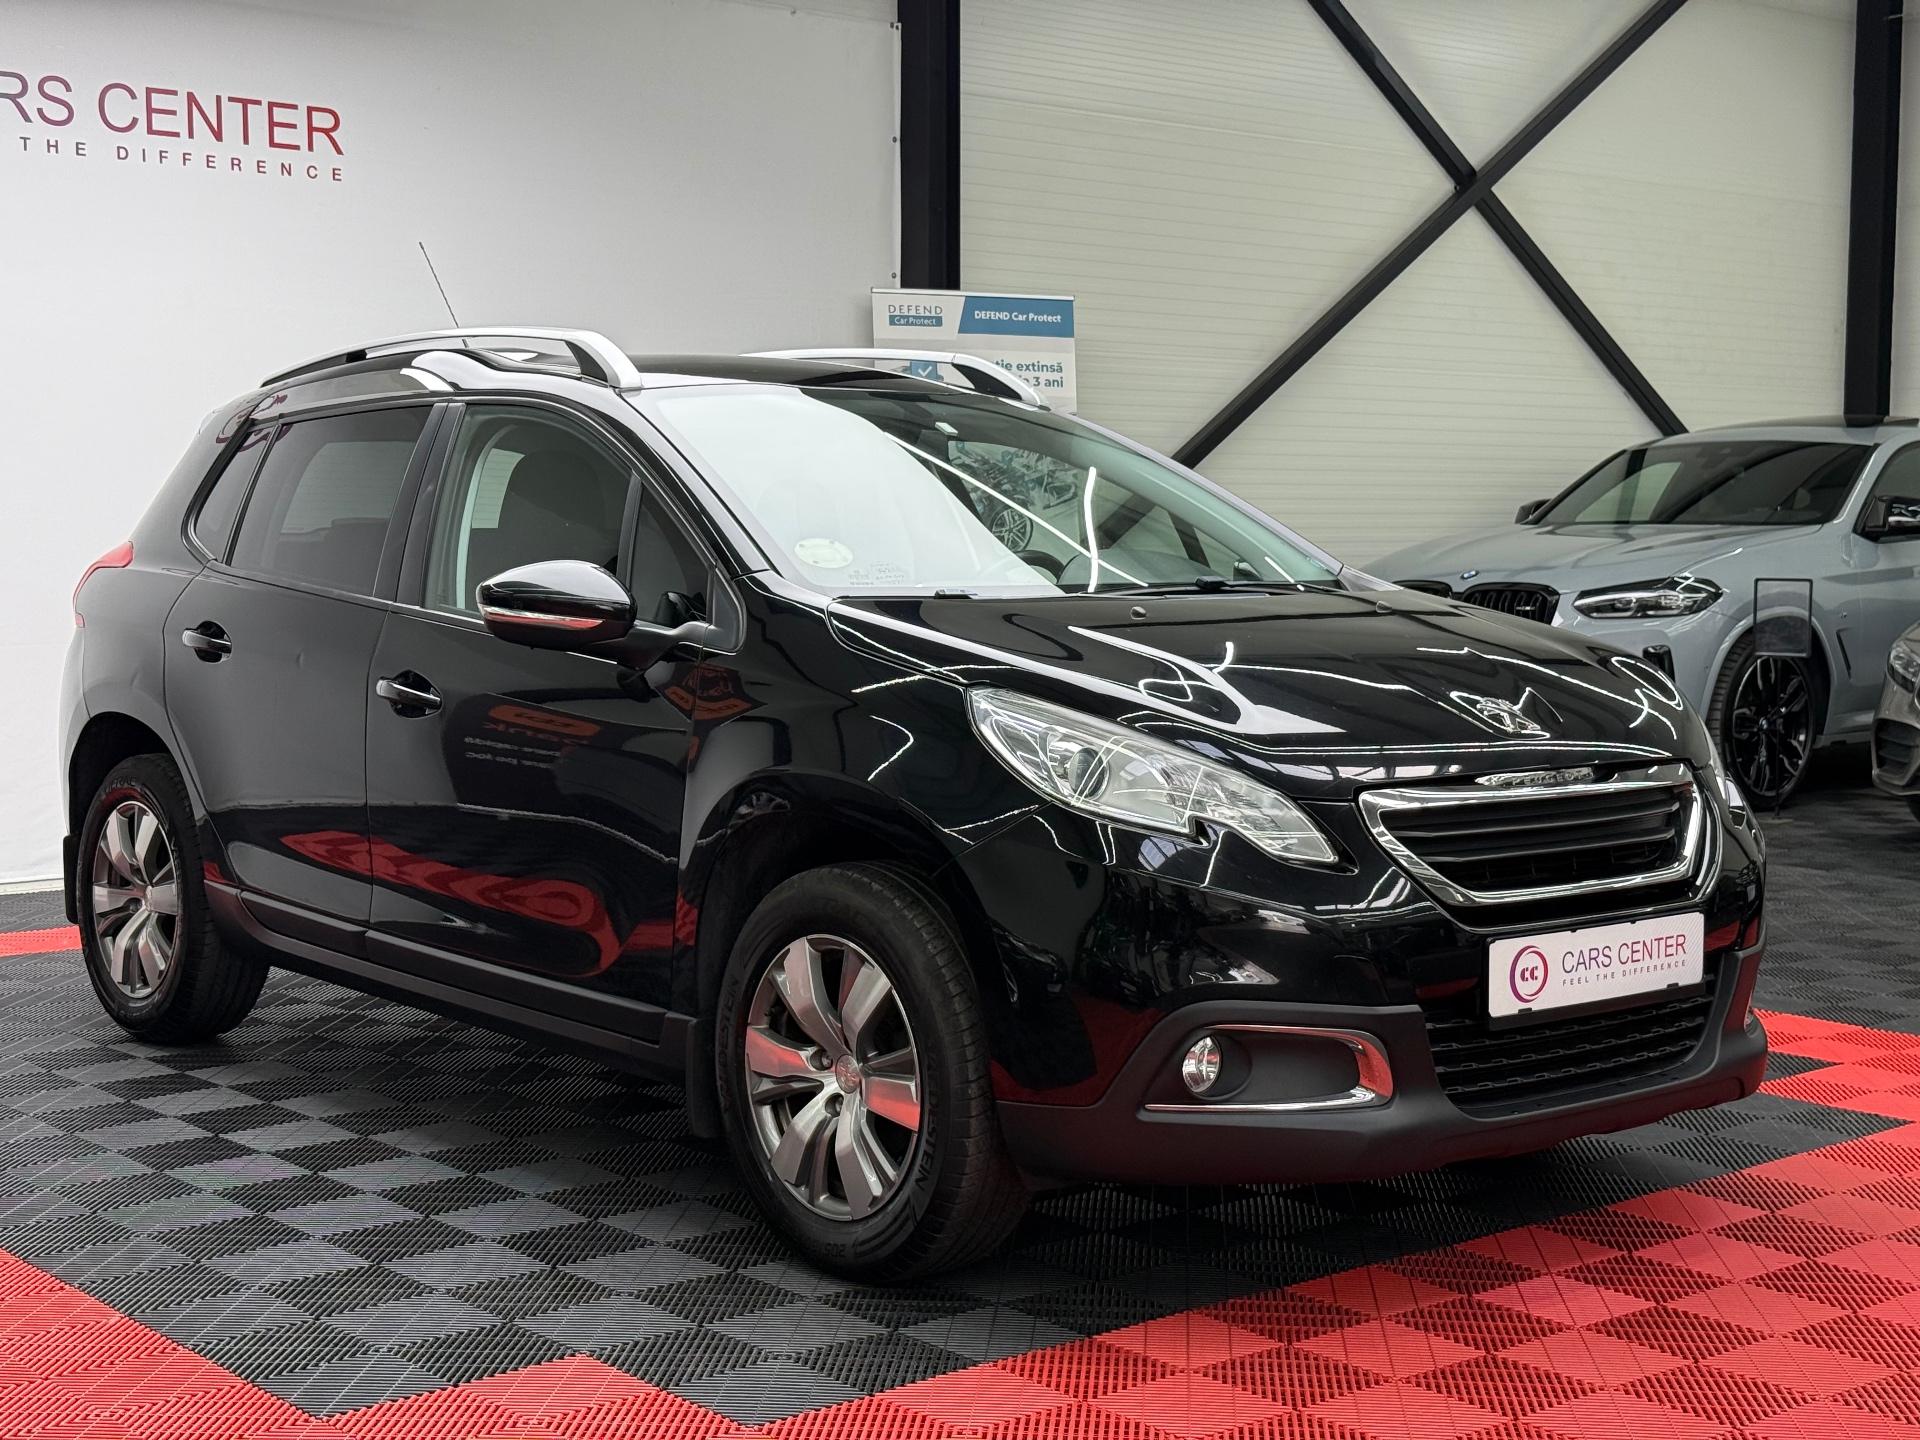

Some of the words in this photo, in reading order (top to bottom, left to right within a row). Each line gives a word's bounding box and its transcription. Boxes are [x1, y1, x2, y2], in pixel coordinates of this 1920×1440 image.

[98, 82, 345, 156] CENTER
[19, 136, 87, 157] THE
[116, 145, 343, 182] DIFFERENCE
[888, 304, 943, 315] DEFEND
[974, 310, 1010, 320] DEFEND
[1011, 312, 1027, 321] Car
[1028, 312, 1062, 323] Protect
[894, 316, 908, 325] Car
[908, 317, 936, 326] Protect
[1016, 360, 1063, 373] extinsă
[1032, 376, 1041, 387] 3
[1044, 376, 1064, 388] ani
[1511, 771, 1584, 786] PEUGEOT
[1562, 945, 1612, 974] CARS
[1618, 934, 1687, 965] CENTER
[1562, 976, 1590, 987] FEEL
[1596, 971, 1615, 981] THE
[1622, 959, 1686, 977] DIFFERENCE
